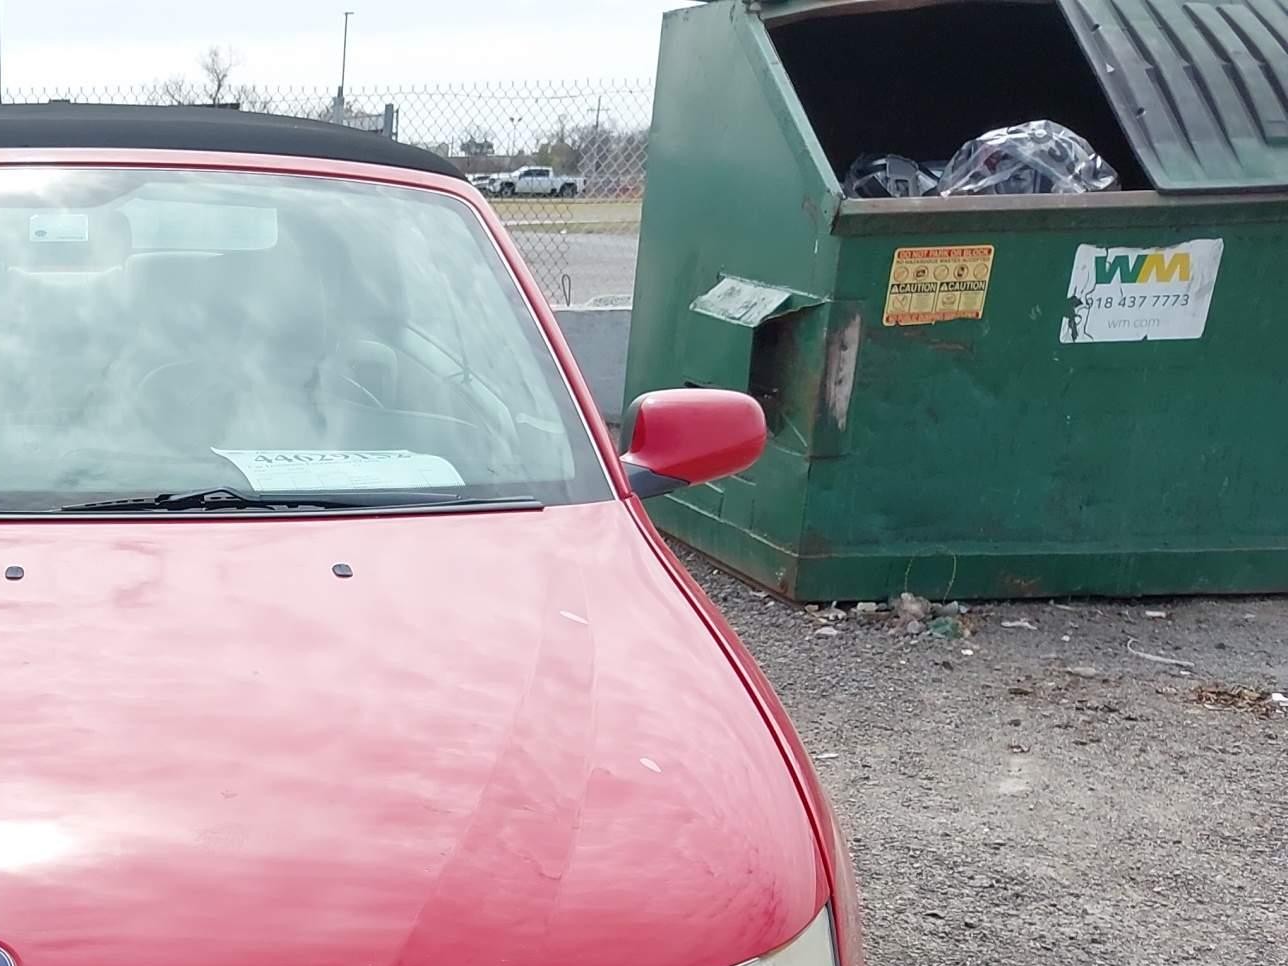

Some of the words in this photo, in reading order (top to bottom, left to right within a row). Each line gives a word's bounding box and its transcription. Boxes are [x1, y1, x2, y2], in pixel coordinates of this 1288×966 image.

[912, 250, 928, 259] NOT
[930, 249, 950, 258] PARK
[964, 248, 989, 257] BLOCK
[1095, 253, 1190, 284] WM
[899, 283, 936, 293] CAUTION
[948, 281, 985, 291] CAUTION
[1086, 296, 1113, 309] 918
[1118, 296, 1147, 308] 437
[1152, 294, 1190, 307] 7773
[1107, 317, 1160, 330] wm.com
